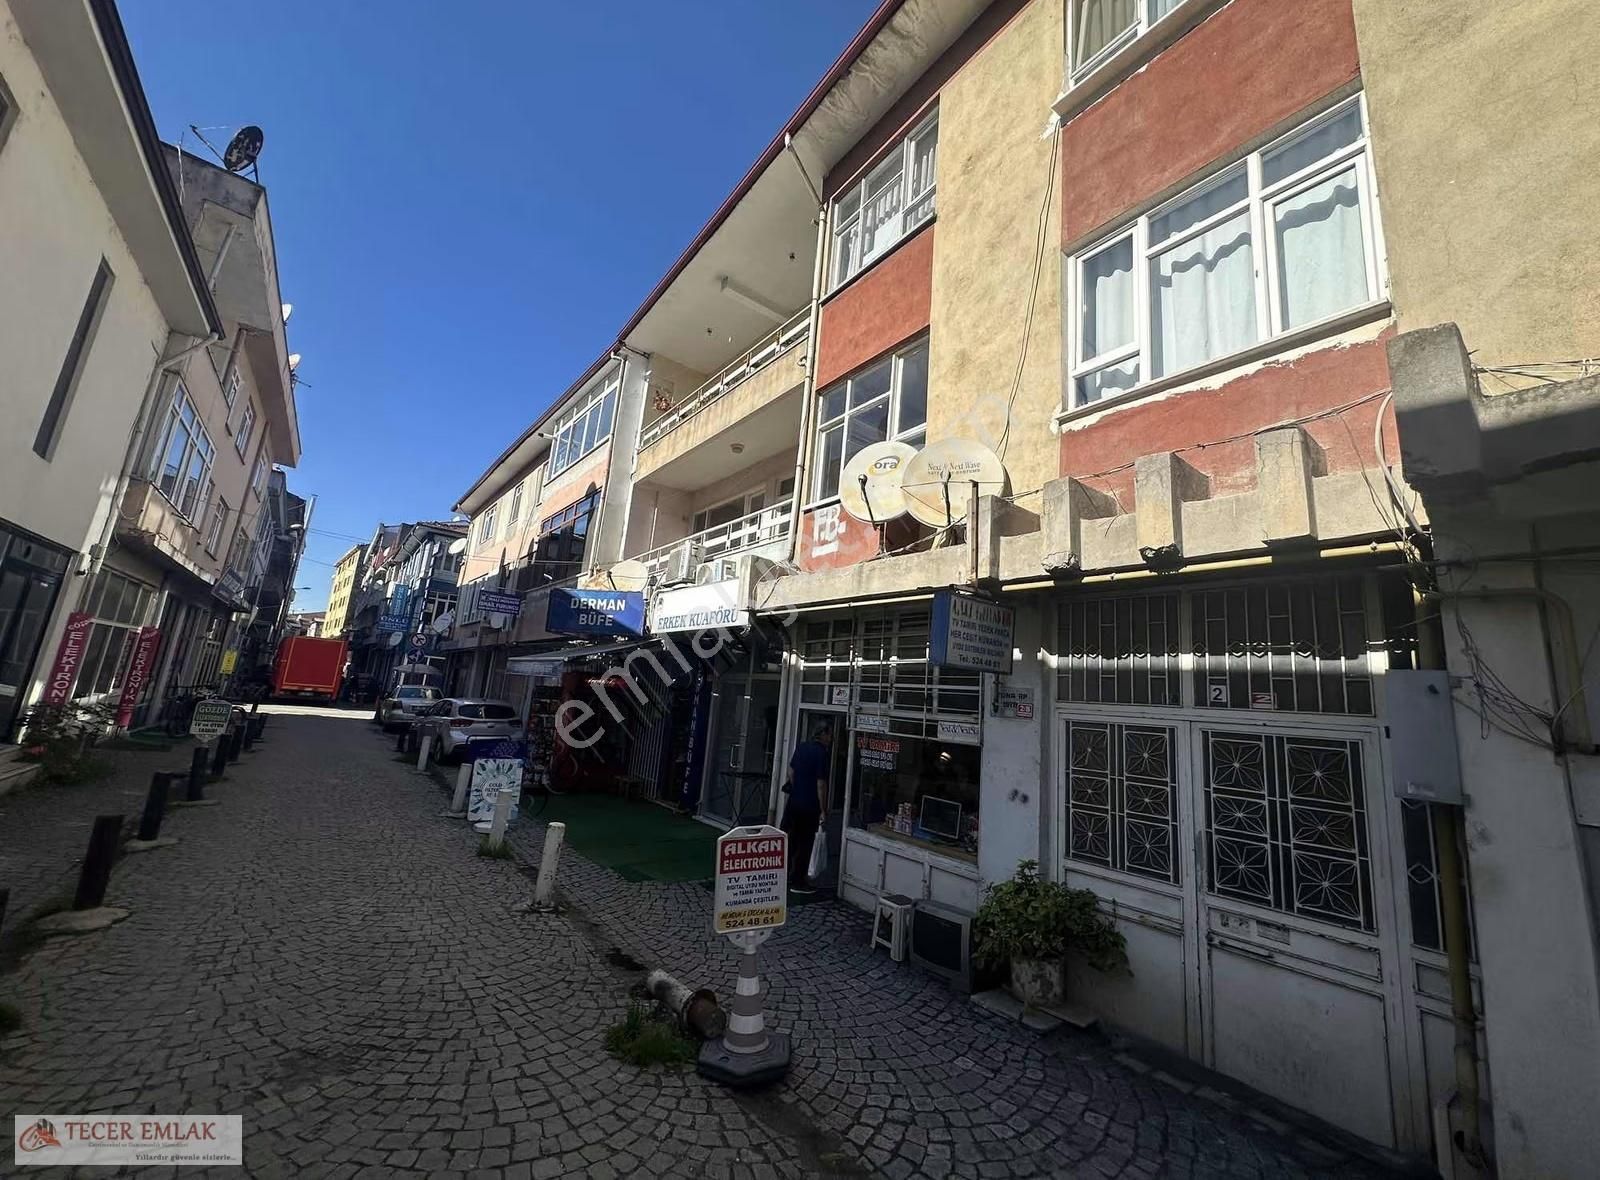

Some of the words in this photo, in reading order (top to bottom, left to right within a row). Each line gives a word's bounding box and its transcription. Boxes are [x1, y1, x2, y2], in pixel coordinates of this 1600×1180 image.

[874, 461, 898, 470] ora
[570, 597, 626, 612] DERMAN
[577, 612, 614, 627] BÜFE
[657, 613, 687, 630] ERKEK
[689, 603, 739, 628] KUAFÖRÜ
[1213, 687, 1222, 701] 2
[724, 841, 781, 856] ALKAN
[727, 876, 740, 884] TV
[725, 919, 744, 929] 524
[748, 917, 760, 926] 48
[764, 916, 775, 925] 61
